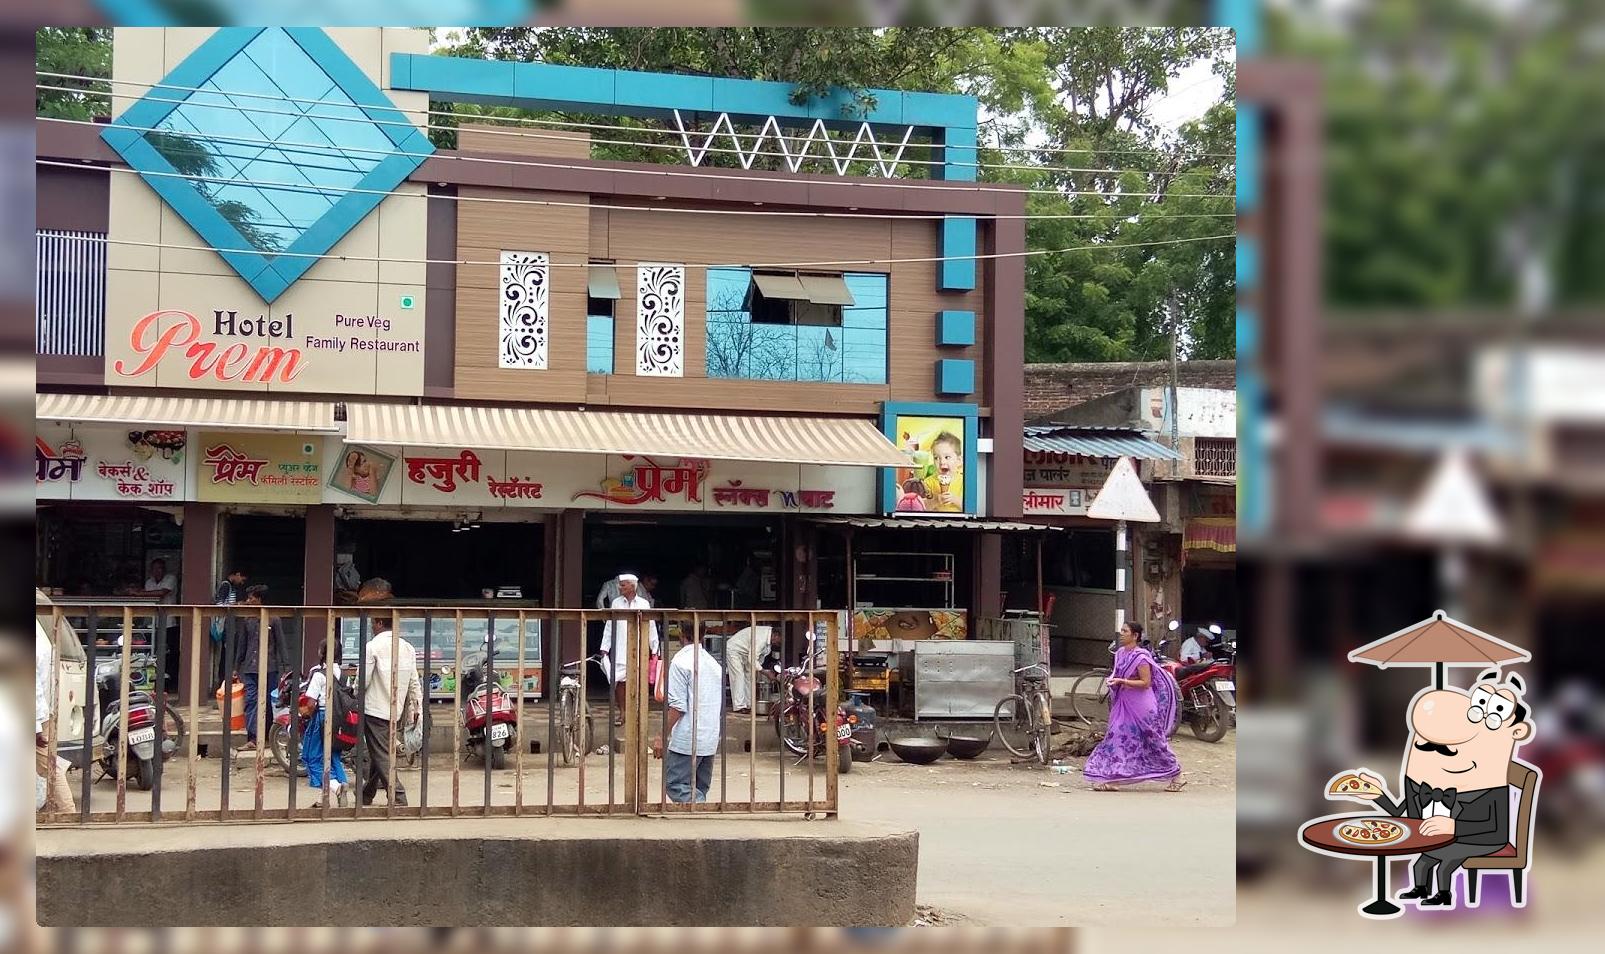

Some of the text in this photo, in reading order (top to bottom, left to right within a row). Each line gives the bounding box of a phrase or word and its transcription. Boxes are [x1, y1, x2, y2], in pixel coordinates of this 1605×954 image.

[213, 310, 293, 338] Hotel
[335, 314, 391, 331] Pure Veg
[114, 310, 308, 384] Prem
[306, 336, 420, 352] Family Restaurant
[98, 461, 132, 478] बेकर्स
[203, 444, 269, 485] प्रेम
[404, 450, 482, 492] हजुरी
[118, 479, 173, 494] केक शॉप
[487, 475, 543, 499] रेस्टॉरंट
